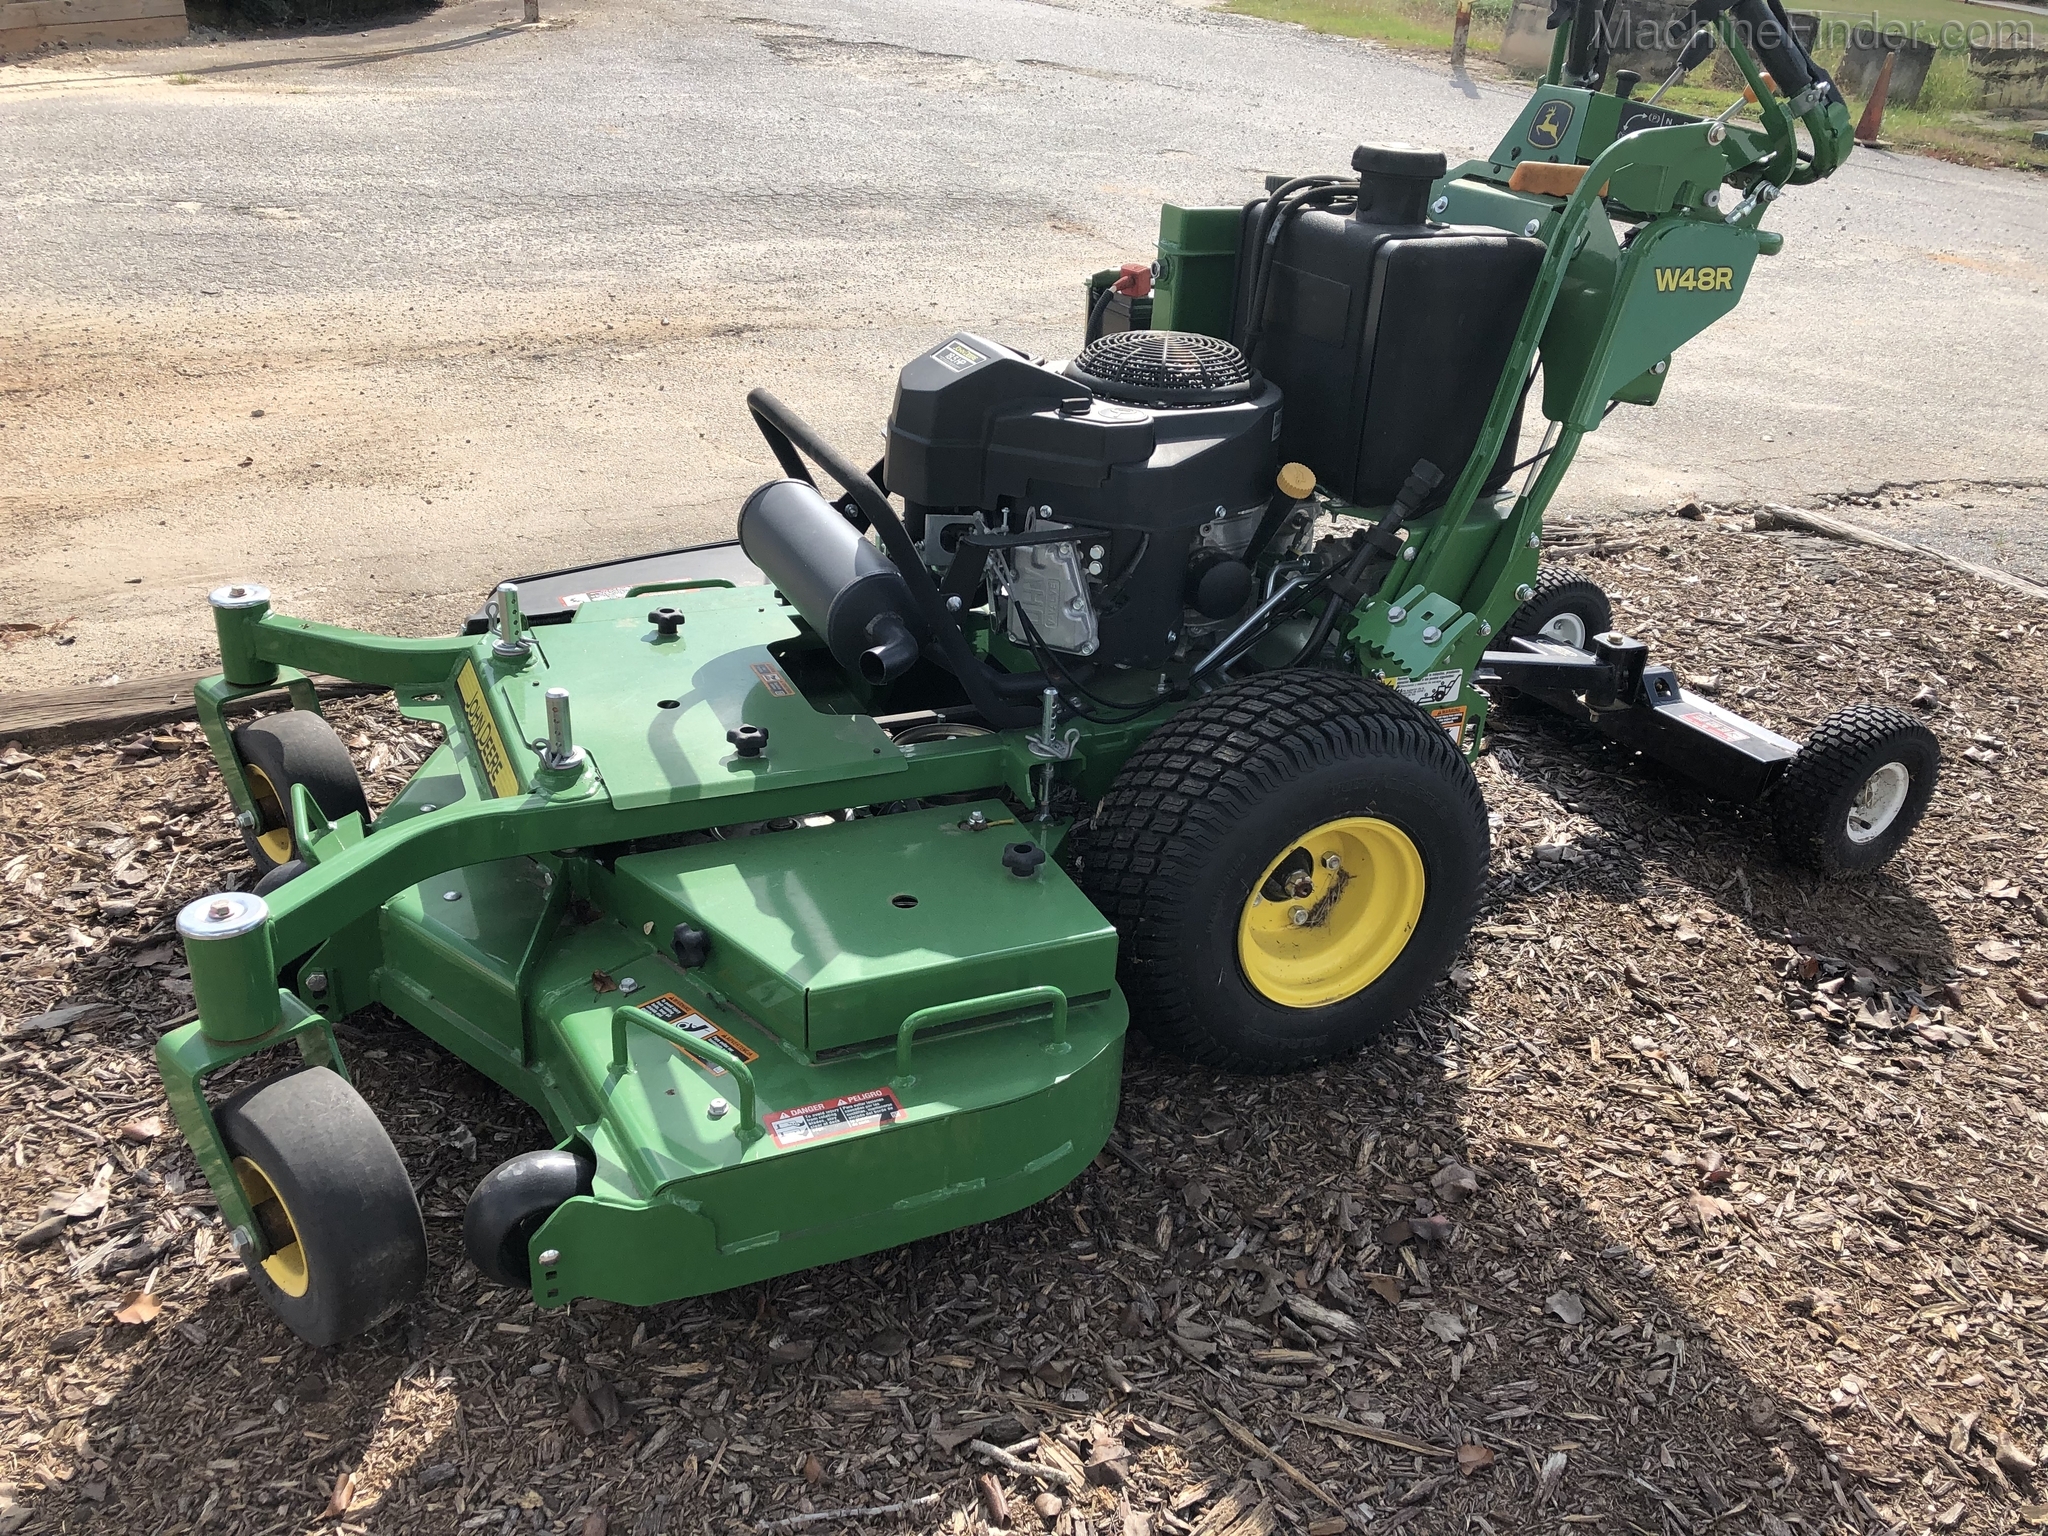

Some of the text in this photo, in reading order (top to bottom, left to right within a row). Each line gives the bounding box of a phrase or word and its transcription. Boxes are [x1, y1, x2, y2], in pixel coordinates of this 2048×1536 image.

[1655, 266, 1734, 293] W48R
[465, 690, 504, 782] JOHN DEERE
[726, 1037, 753, 1057] ADVERTENCIA
[847, 1089, 883, 1104] PELIGRO
[790, 1103, 825, 1117] DANGER
